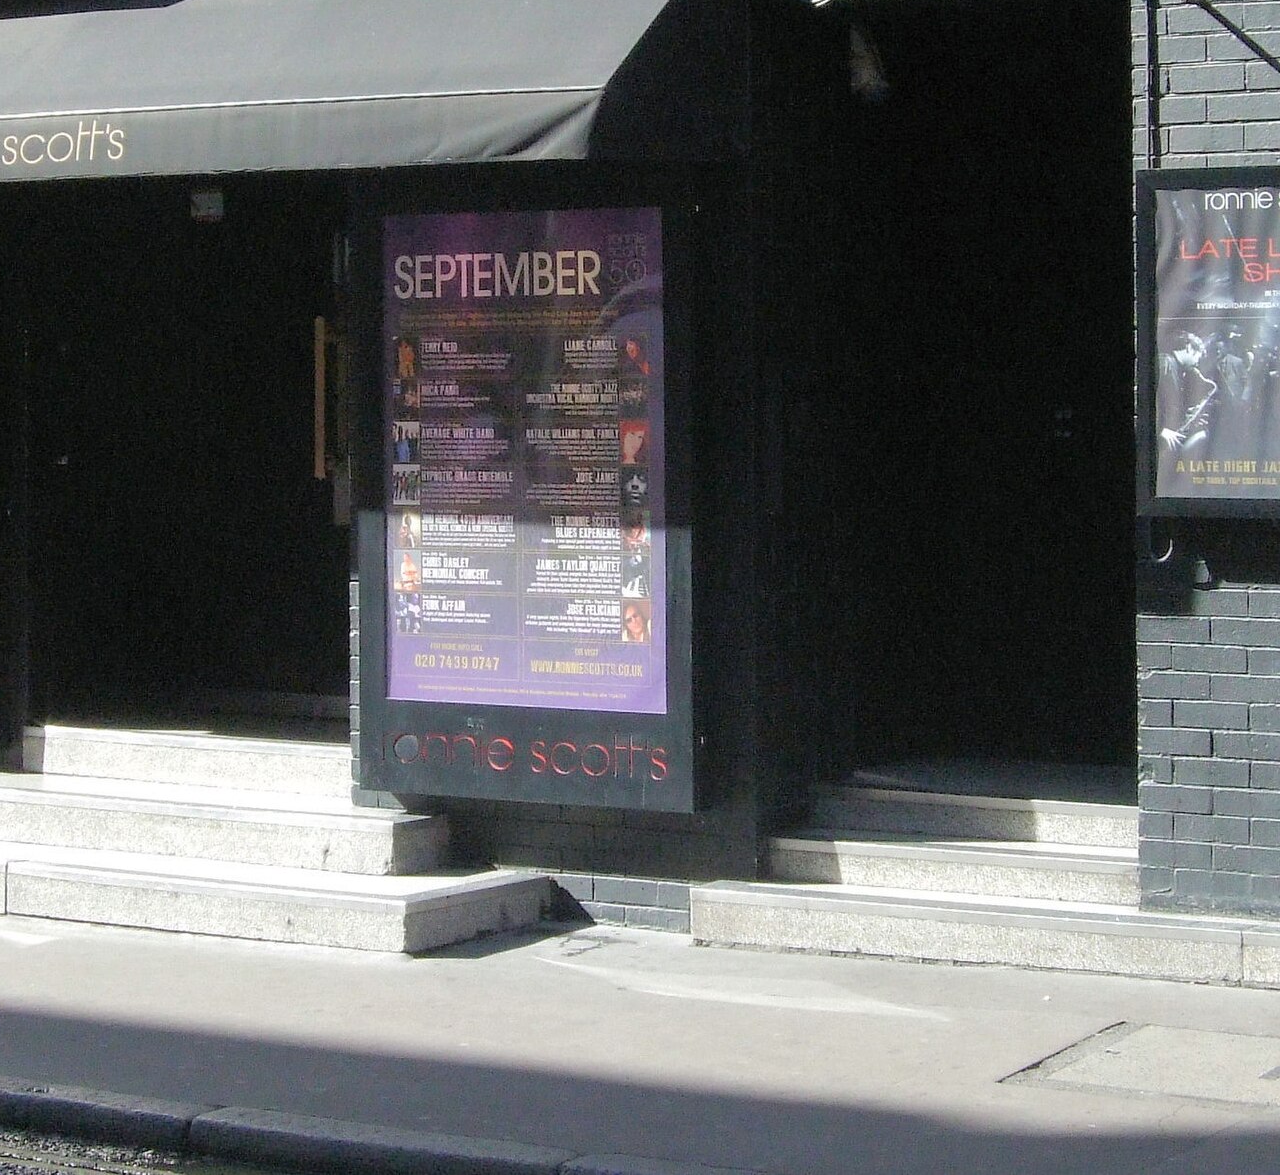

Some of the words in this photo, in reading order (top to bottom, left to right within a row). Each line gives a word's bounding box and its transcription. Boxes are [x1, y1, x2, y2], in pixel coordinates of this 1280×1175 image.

[1, 119, 125, 165] scott's
[1204, 187, 1273, 211] ronnie
[1180, 237, 1258, 261] LATE
[393, 250, 602, 300] SEPTEMBER
[1176, 461, 1186, 474] A
[1189, 461, 1219, 474] LATE
[1223, 461, 1257, 474] NIGHT
[556, 527, 578, 538] BLUES
[579, 528, 621, 539] EXPERIENCE
[535, 559, 560, 570] JAMES
[562, 560, 588, 571] TAYLOR
[589, 561, 621, 572] QUARTET
[415, 654, 436, 668] 020
[440, 655, 468, 669] 7439
[472, 656, 500, 671] 0747
[380, 731, 515, 771] ronnie
[530, 733, 668, 781] scott's
